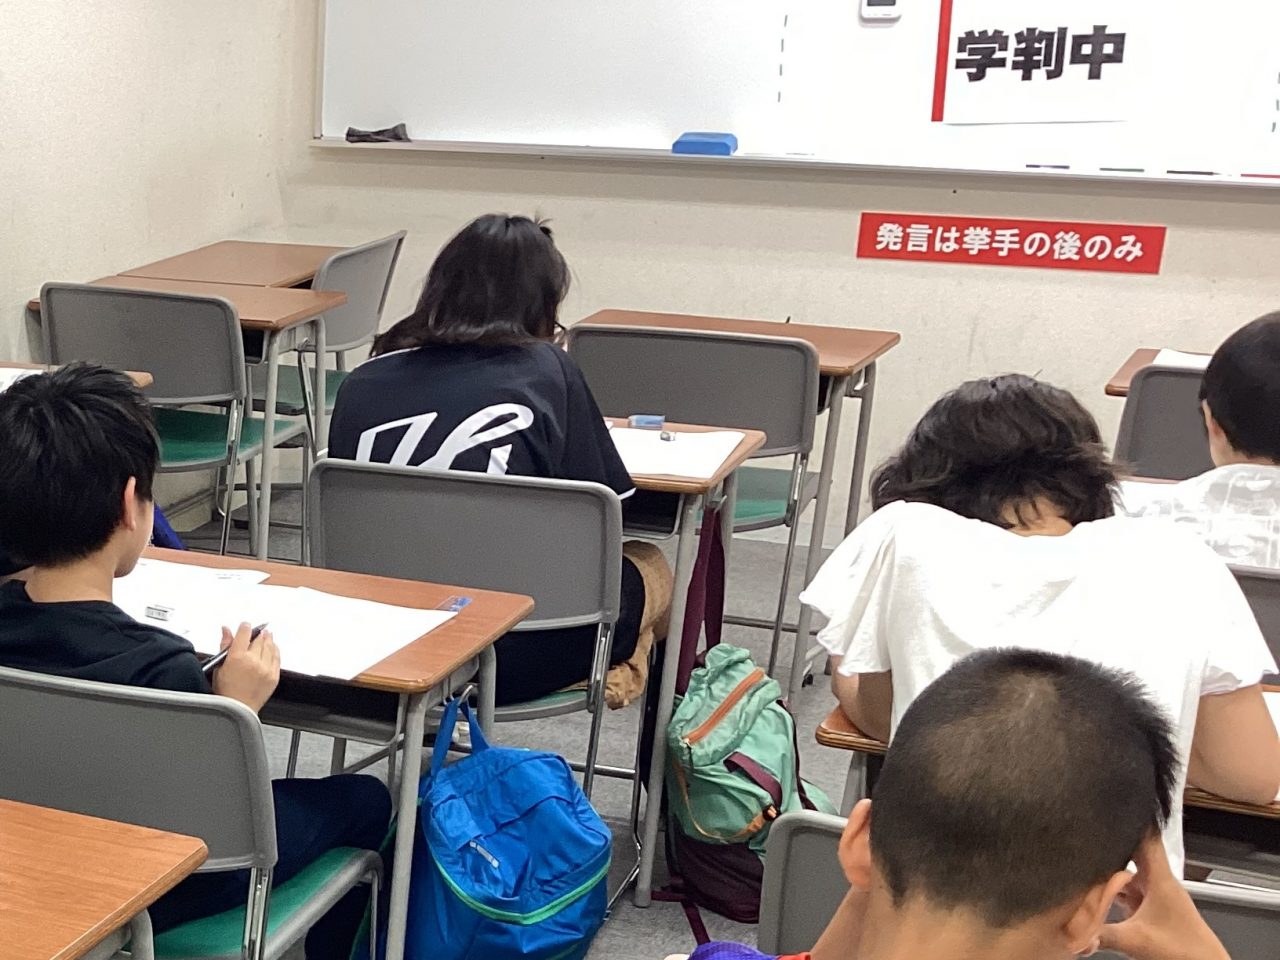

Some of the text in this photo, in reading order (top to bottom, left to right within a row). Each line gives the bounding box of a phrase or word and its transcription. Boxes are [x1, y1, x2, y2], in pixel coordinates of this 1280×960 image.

[955, 25, 1126, 82] 学判中
[875, 222, 1144, 262] 発言は挙手の後のみ
